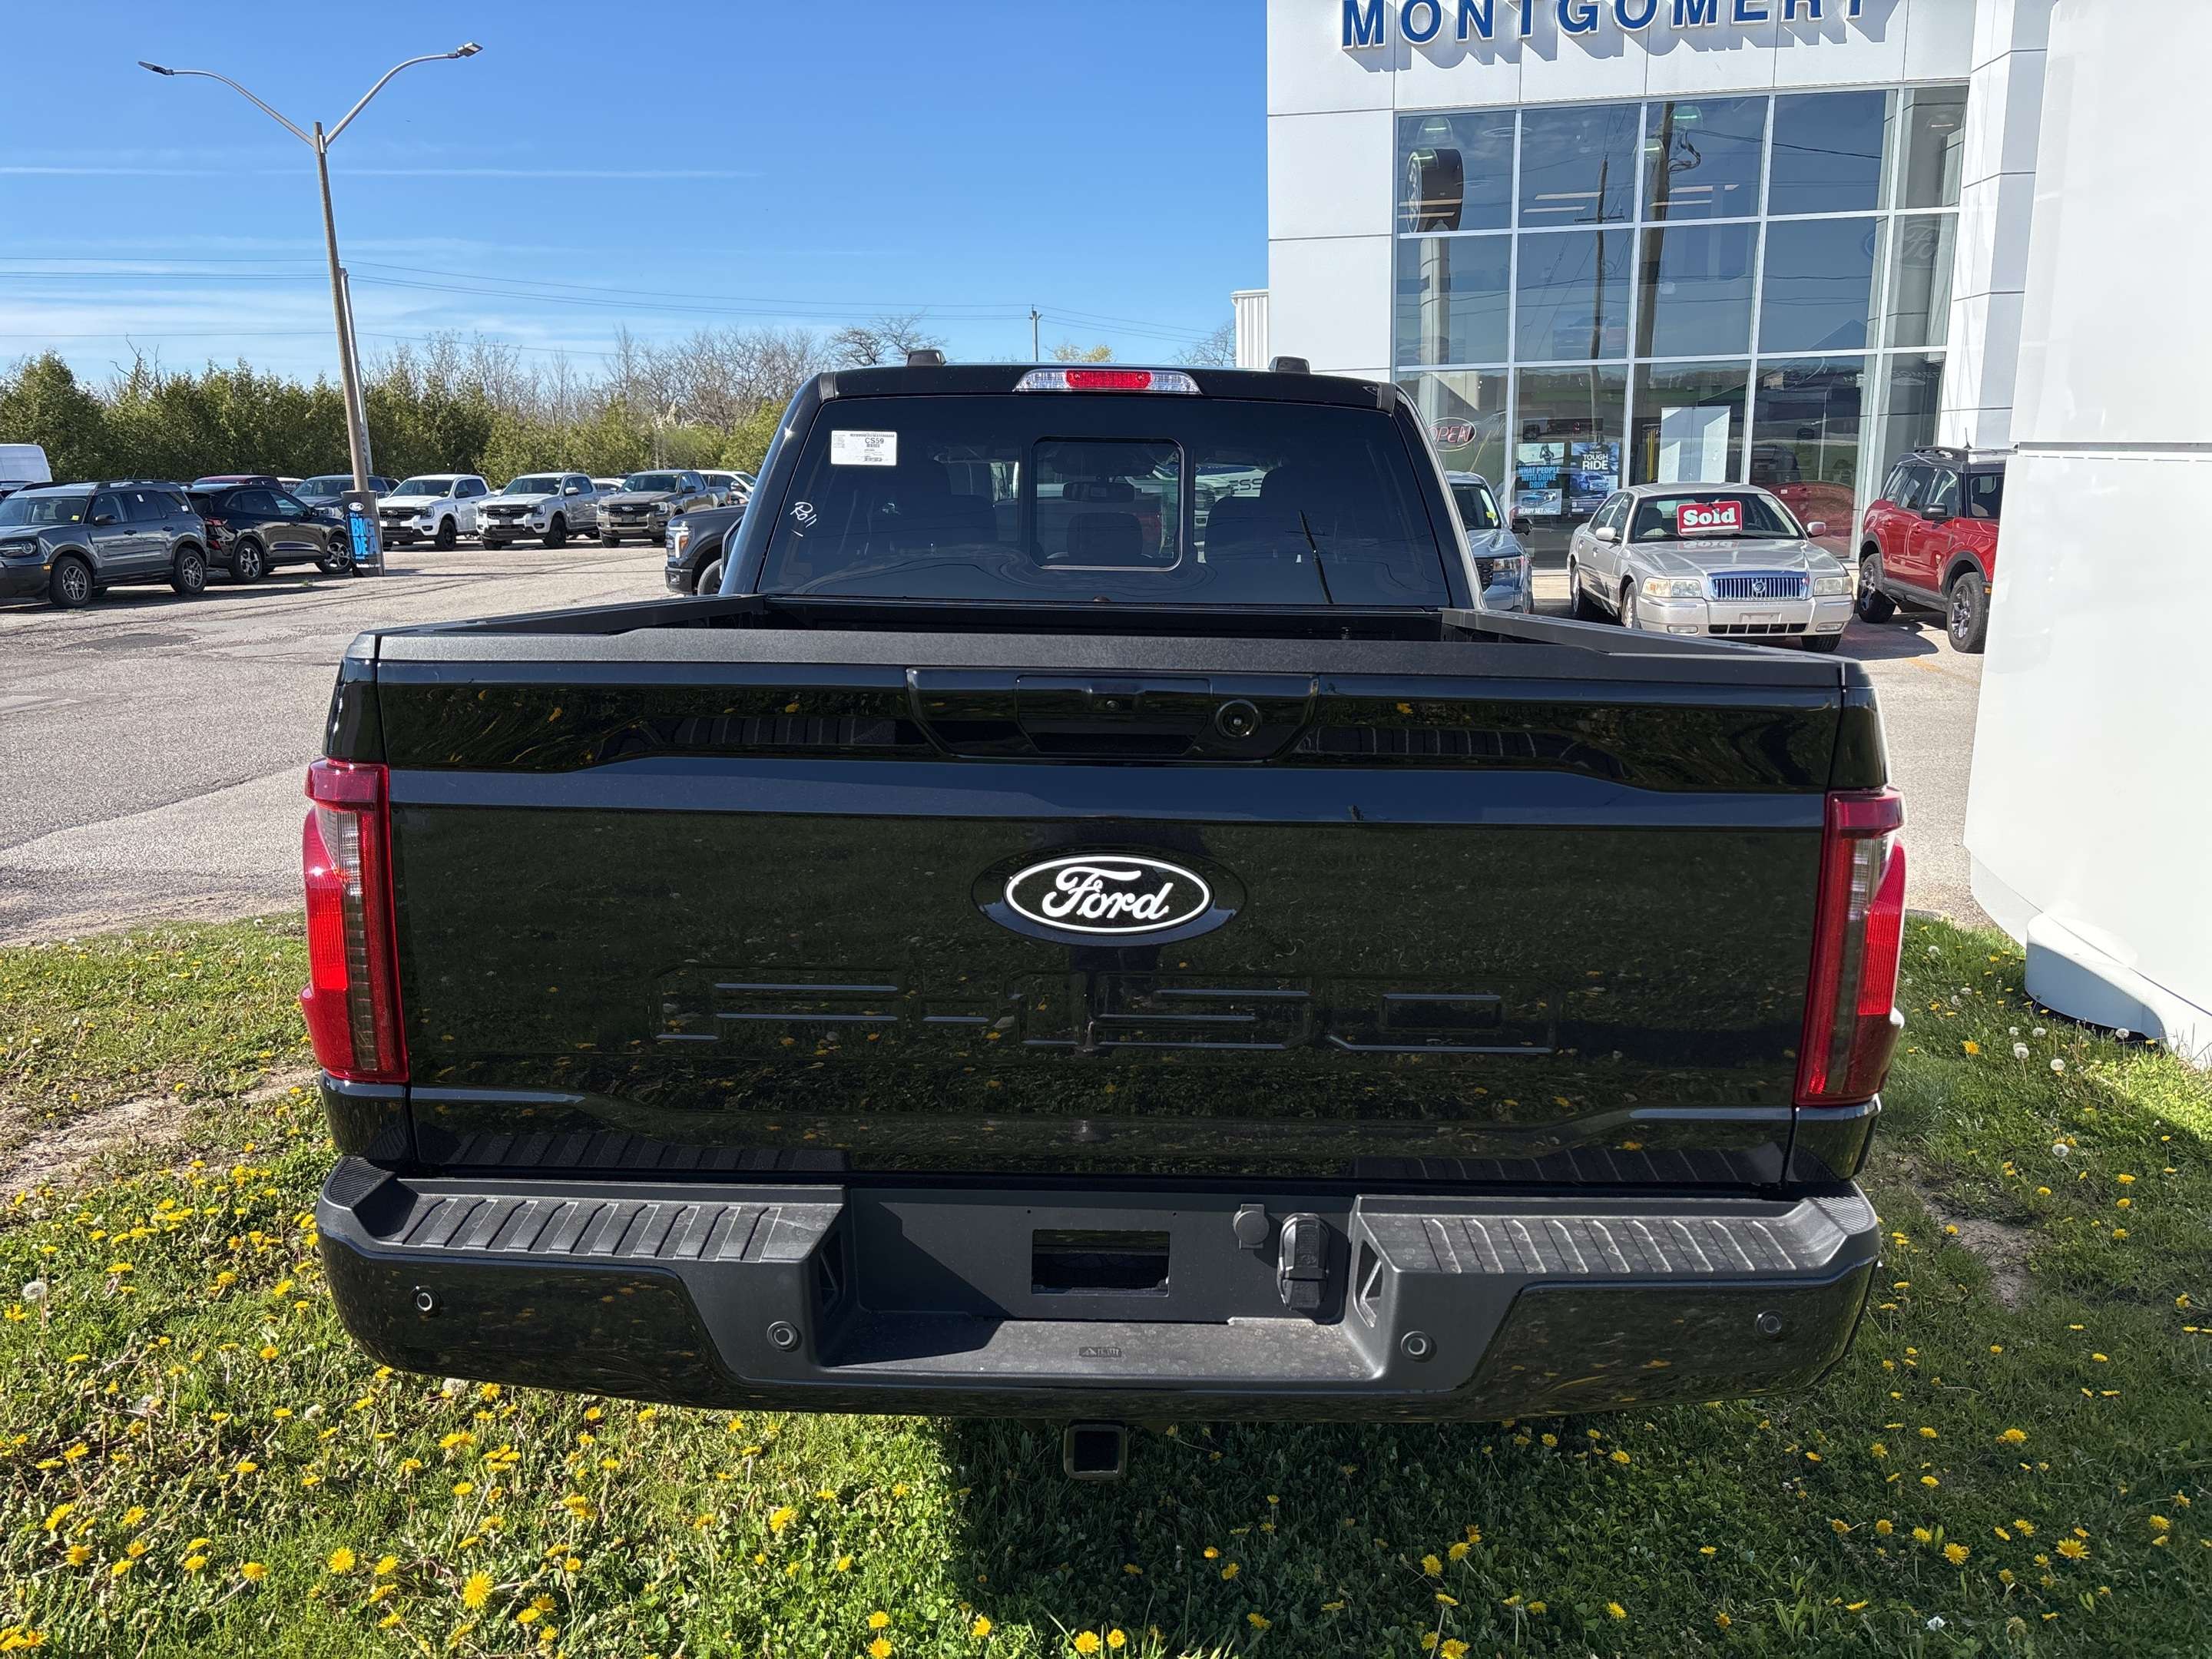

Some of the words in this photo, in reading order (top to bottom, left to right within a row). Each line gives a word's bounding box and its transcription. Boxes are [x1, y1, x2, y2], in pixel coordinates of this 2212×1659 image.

[1429, 426, 1472, 443] OPEN
[1582, 461, 1609, 470] RIDE
[1684, 508, 1737, 525] Sold
[350, 518, 376, 536] BIG
[1042, 866, 1174, 919] Ford
